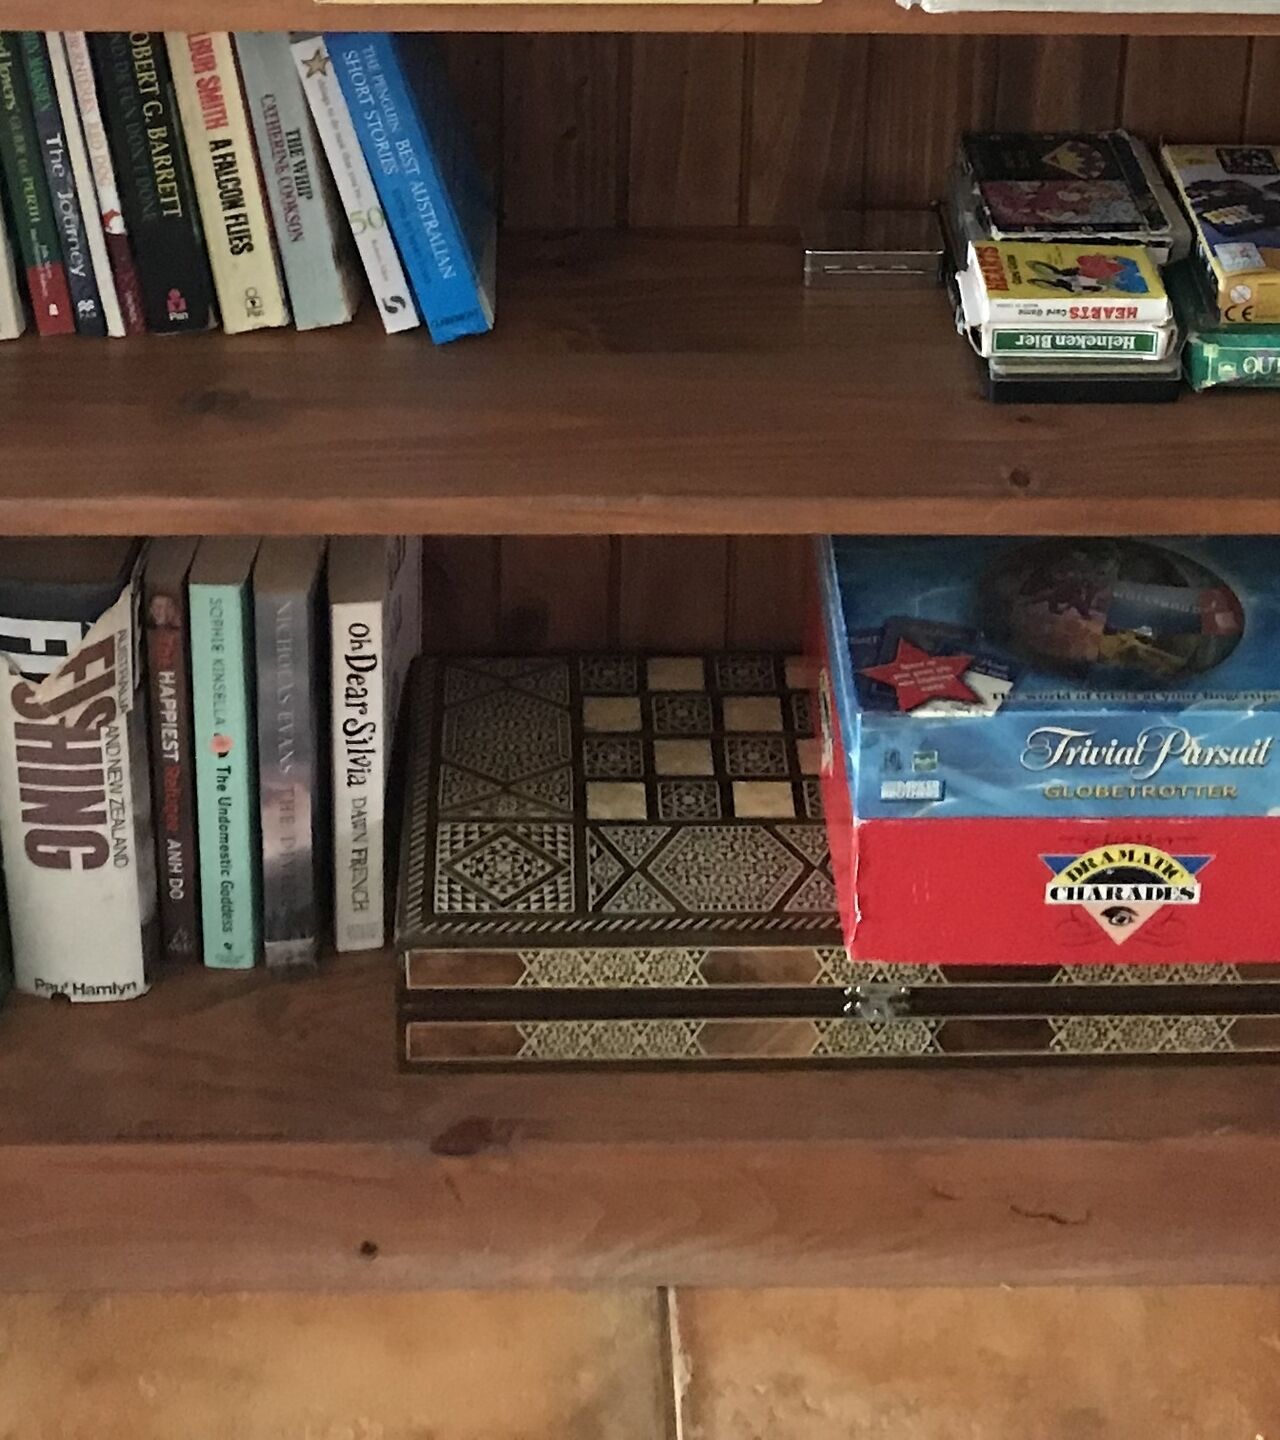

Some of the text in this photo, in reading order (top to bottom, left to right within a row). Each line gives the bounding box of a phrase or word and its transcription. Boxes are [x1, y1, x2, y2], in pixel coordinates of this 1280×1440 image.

[128, 30, 183, 219] OBERT G. BARRETT
[195, 73, 230, 131] SMITH
[342, 50, 400, 178] SHORT STORIES
[259, 93, 306, 243] CATHERINE COOKSON
[285, 126, 314, 201] THE WHIP
[361, 44, 381, 77] THE
[373, 73, 401, 133] PENGUIN
[395, 137, 421, 180] BEST
[408, 180, 458, 280] AUSTRALIAN
[21, 176, 42, 224] PERTH
[45, 132, 87, 278] The Journey
[208, 137, 254, 257] A FALCON FLIES
[349, 206, 385, 238] 50
[1047, 308, 1068, 320] Card
[1069, 305, 1138, 321] HEARTS
[1015, 332, 1136, 351] Heineken Bier
[208, 597, 227, 726] SOPHIE KINSELLA
[275, 599, 294, 776] NICHOLAS EVANS
[157, 670, 181, 762] HAPPIEST
[341, 623, 378, 788] Oh Dear Silvia
[1023, 690, 1072, 702] world
[101, 629, 131, 871] AUSTRALIA AND NEW ZEALAND
[1020, 725, 1275, 780] Trivial Pursuit
[216, 765, 232, 792] The
[1042, 783, 1238, 801] GLOBETROTTER
[276, 785, 296, 827] THE
[349, 797, 369, 842] DAWN
[166, 838, 184, 876] ANH
[216, 796, 234, 878] Undomestic
[169, 877, 185, 901] DO
[349, 842, 371, 913] FRENCH
[1065, 848, 1184, 882] DRAMATIC
[218, 879, 235, 933] Goddess
[1049, 884, 1195, 902] CHARADES
[72, 979, 138, 997] Hamlyn
